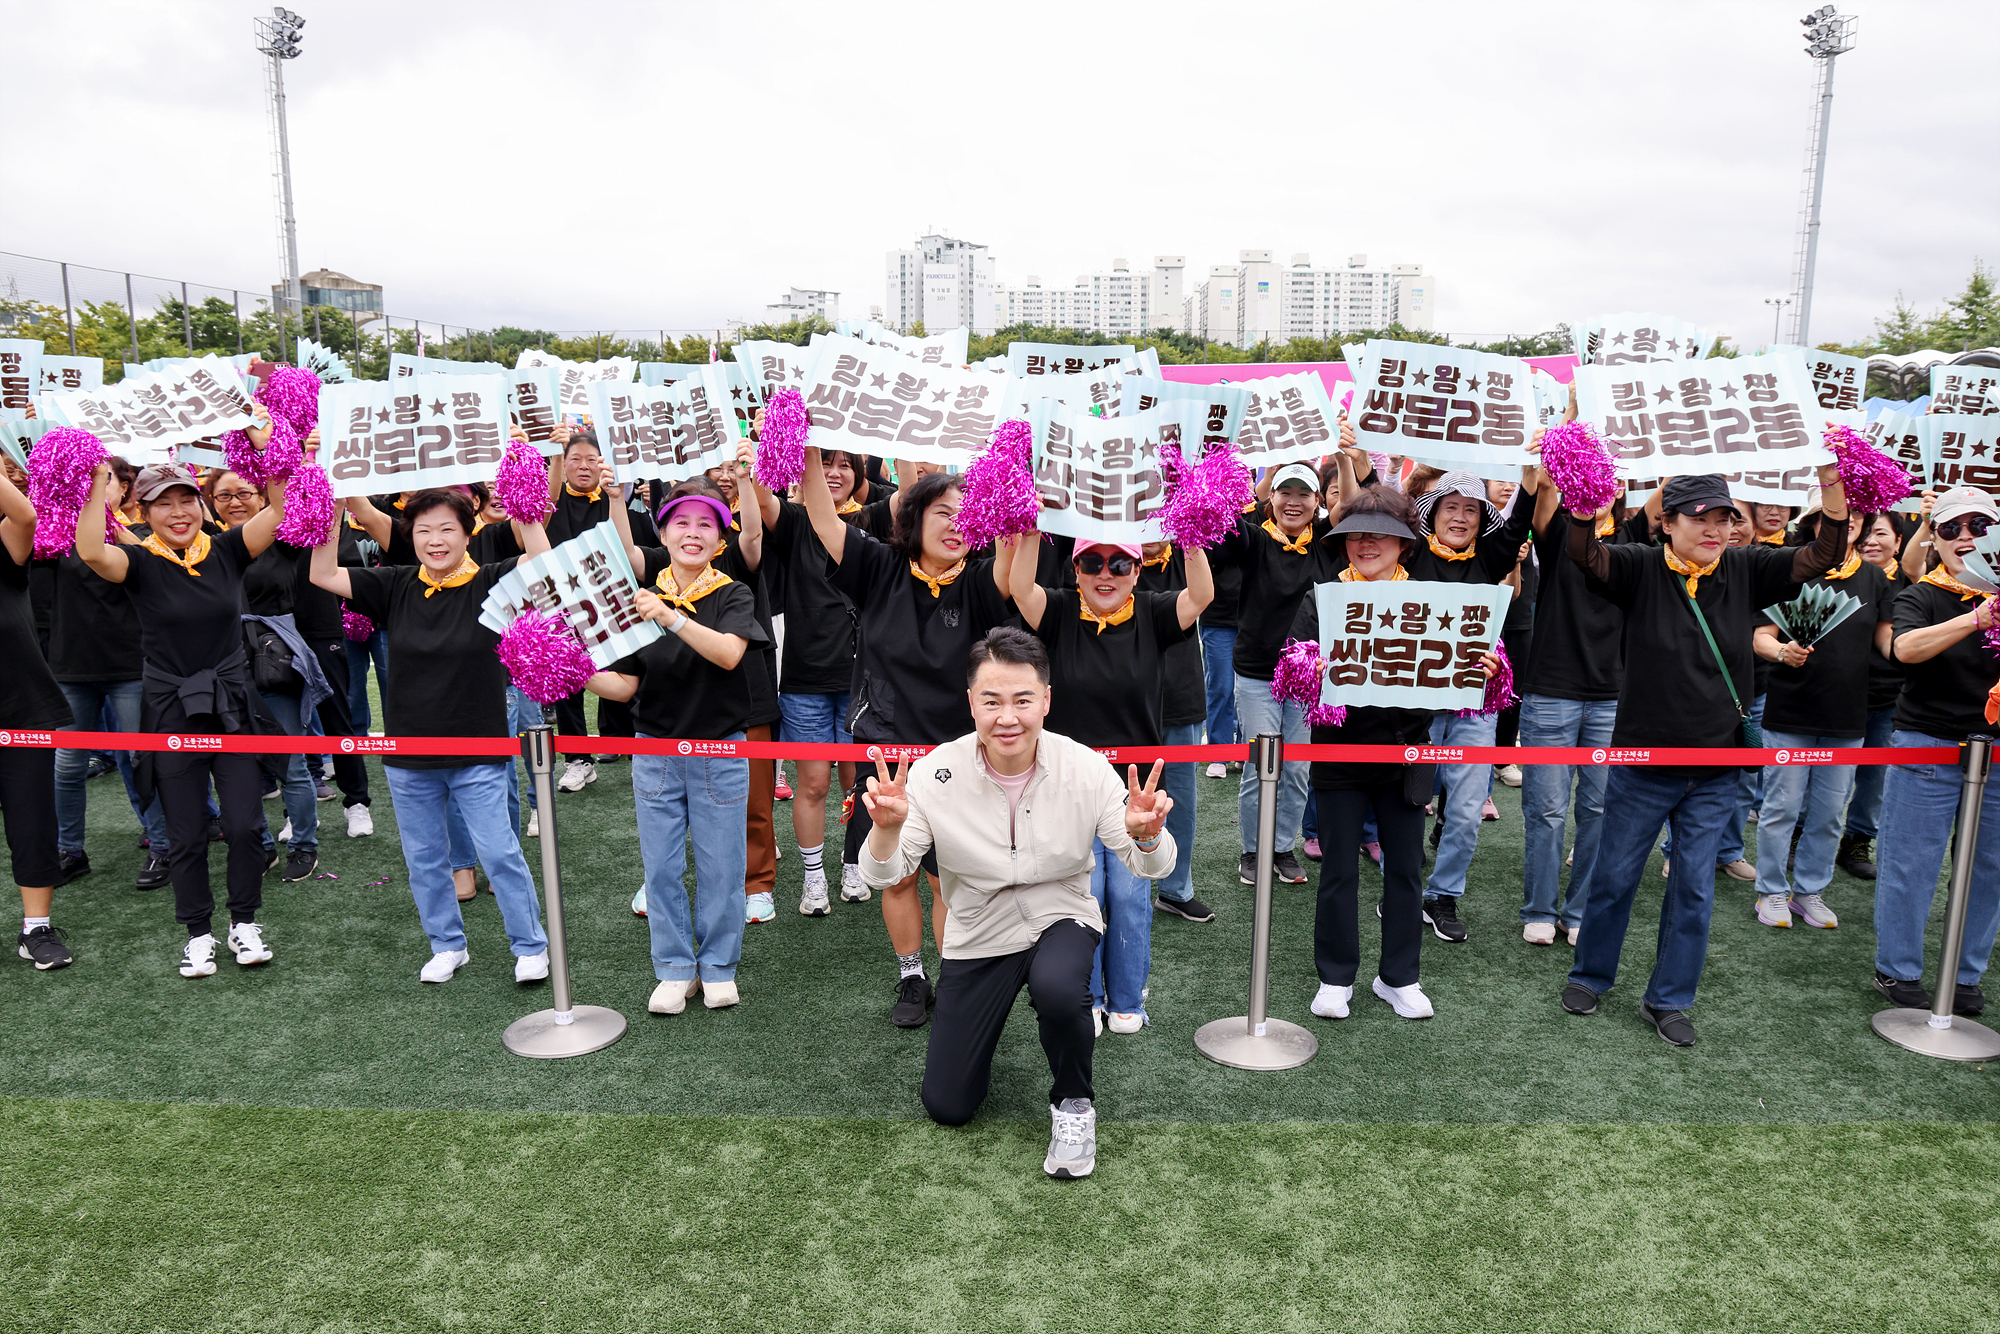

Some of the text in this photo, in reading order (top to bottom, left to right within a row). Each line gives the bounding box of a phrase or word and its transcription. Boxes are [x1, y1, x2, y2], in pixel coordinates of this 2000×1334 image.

[806, 383, 995, 451] 쌍문2동
[1359, 389, 1525, 446] 쌍문2동
[1812, 380, 1859, 410] 2동
[332, 422, 502, 480] 쌍문2동
[608, 407, 727, 466] 쌍문2동
[1237, 408, 1330, 455] 문2동
[1605, 402, 1810, 459] 쌍문2동
[1035, 456, 1175, 523] 쌍문2
[562, 575, 645, 649] 2동
[1329, 638, 1490, 689] 쌍문2동
[1610, 750, 1650, 758] 도봉구체육회
